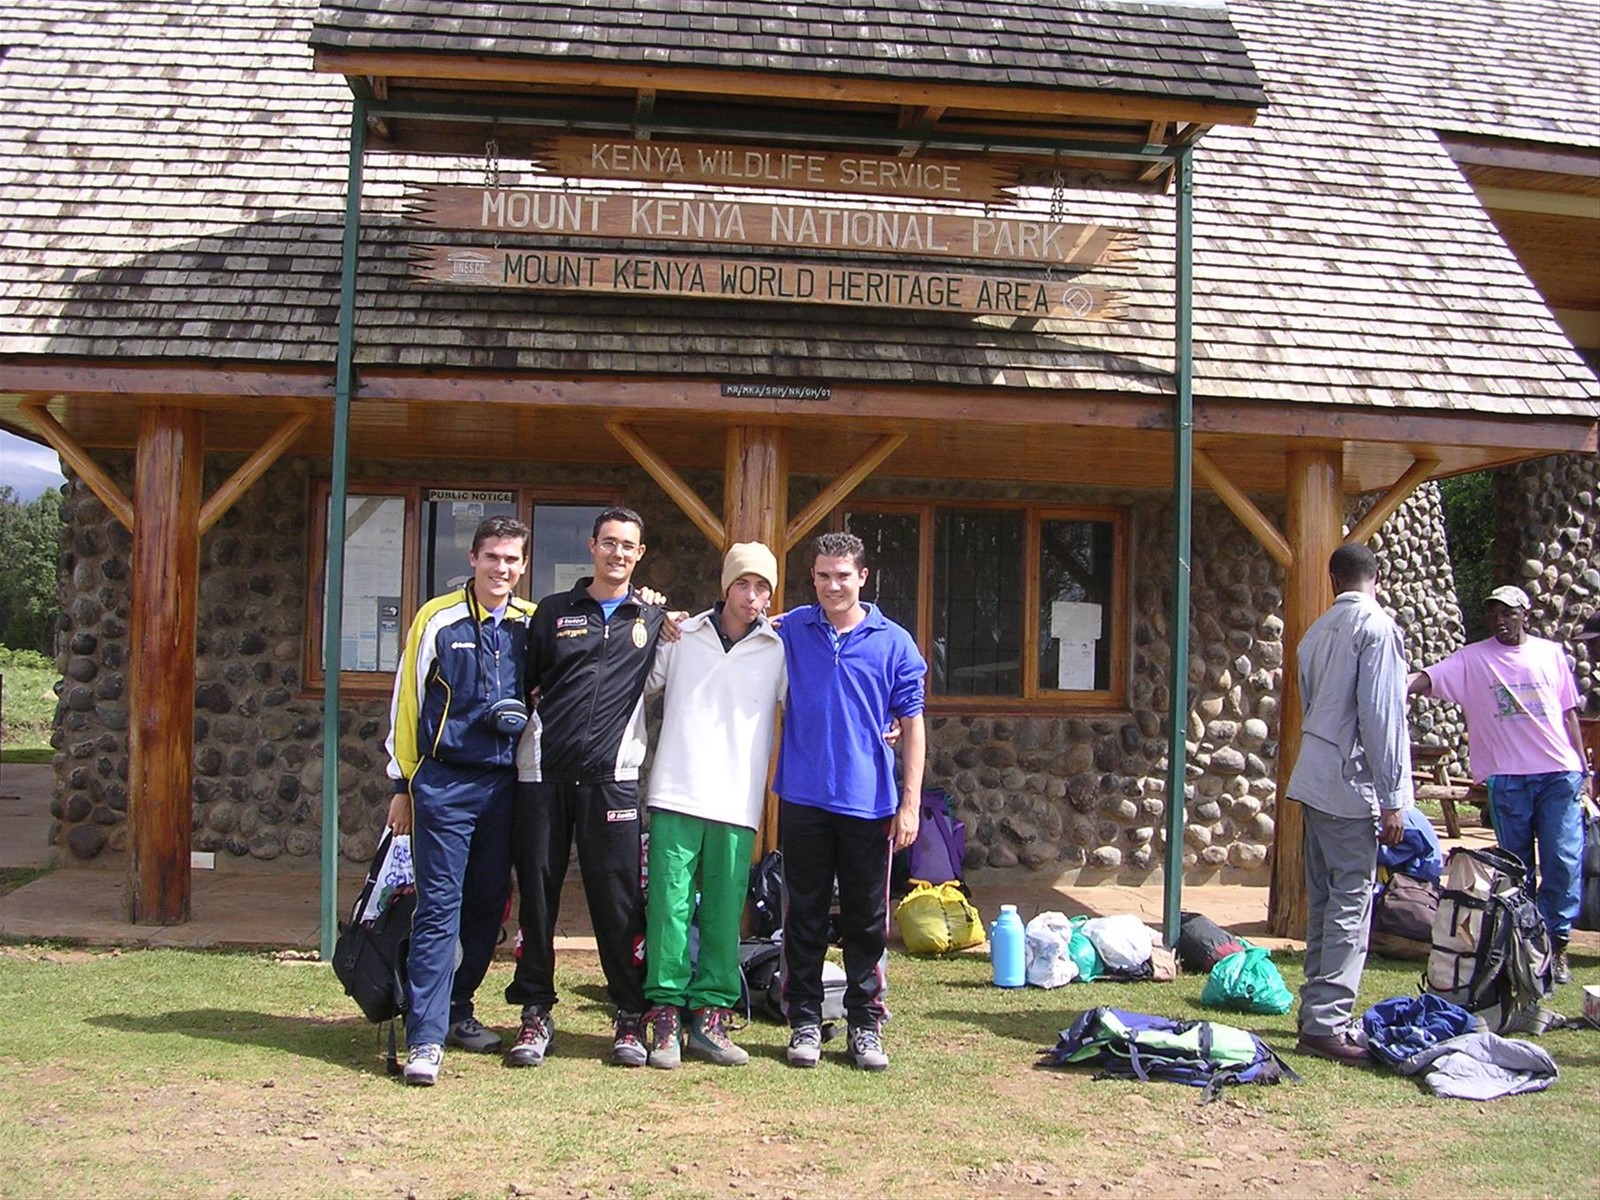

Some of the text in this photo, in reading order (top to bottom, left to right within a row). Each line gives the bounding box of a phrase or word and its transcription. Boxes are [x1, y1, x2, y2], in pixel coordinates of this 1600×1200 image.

[591, 143, 961, 192] KENYA WILDLIFE SERVICE
[481, 191, 1064, 260] MOUNT KENYA NATIONAL PARK
[453, 261, 485, 274] UNESCO
[503, 253, 1050, 313] MOUNT KENYA WORLD HERITAGE AREA
[430, 490, 511, 502] PUBLIC NOTICE
